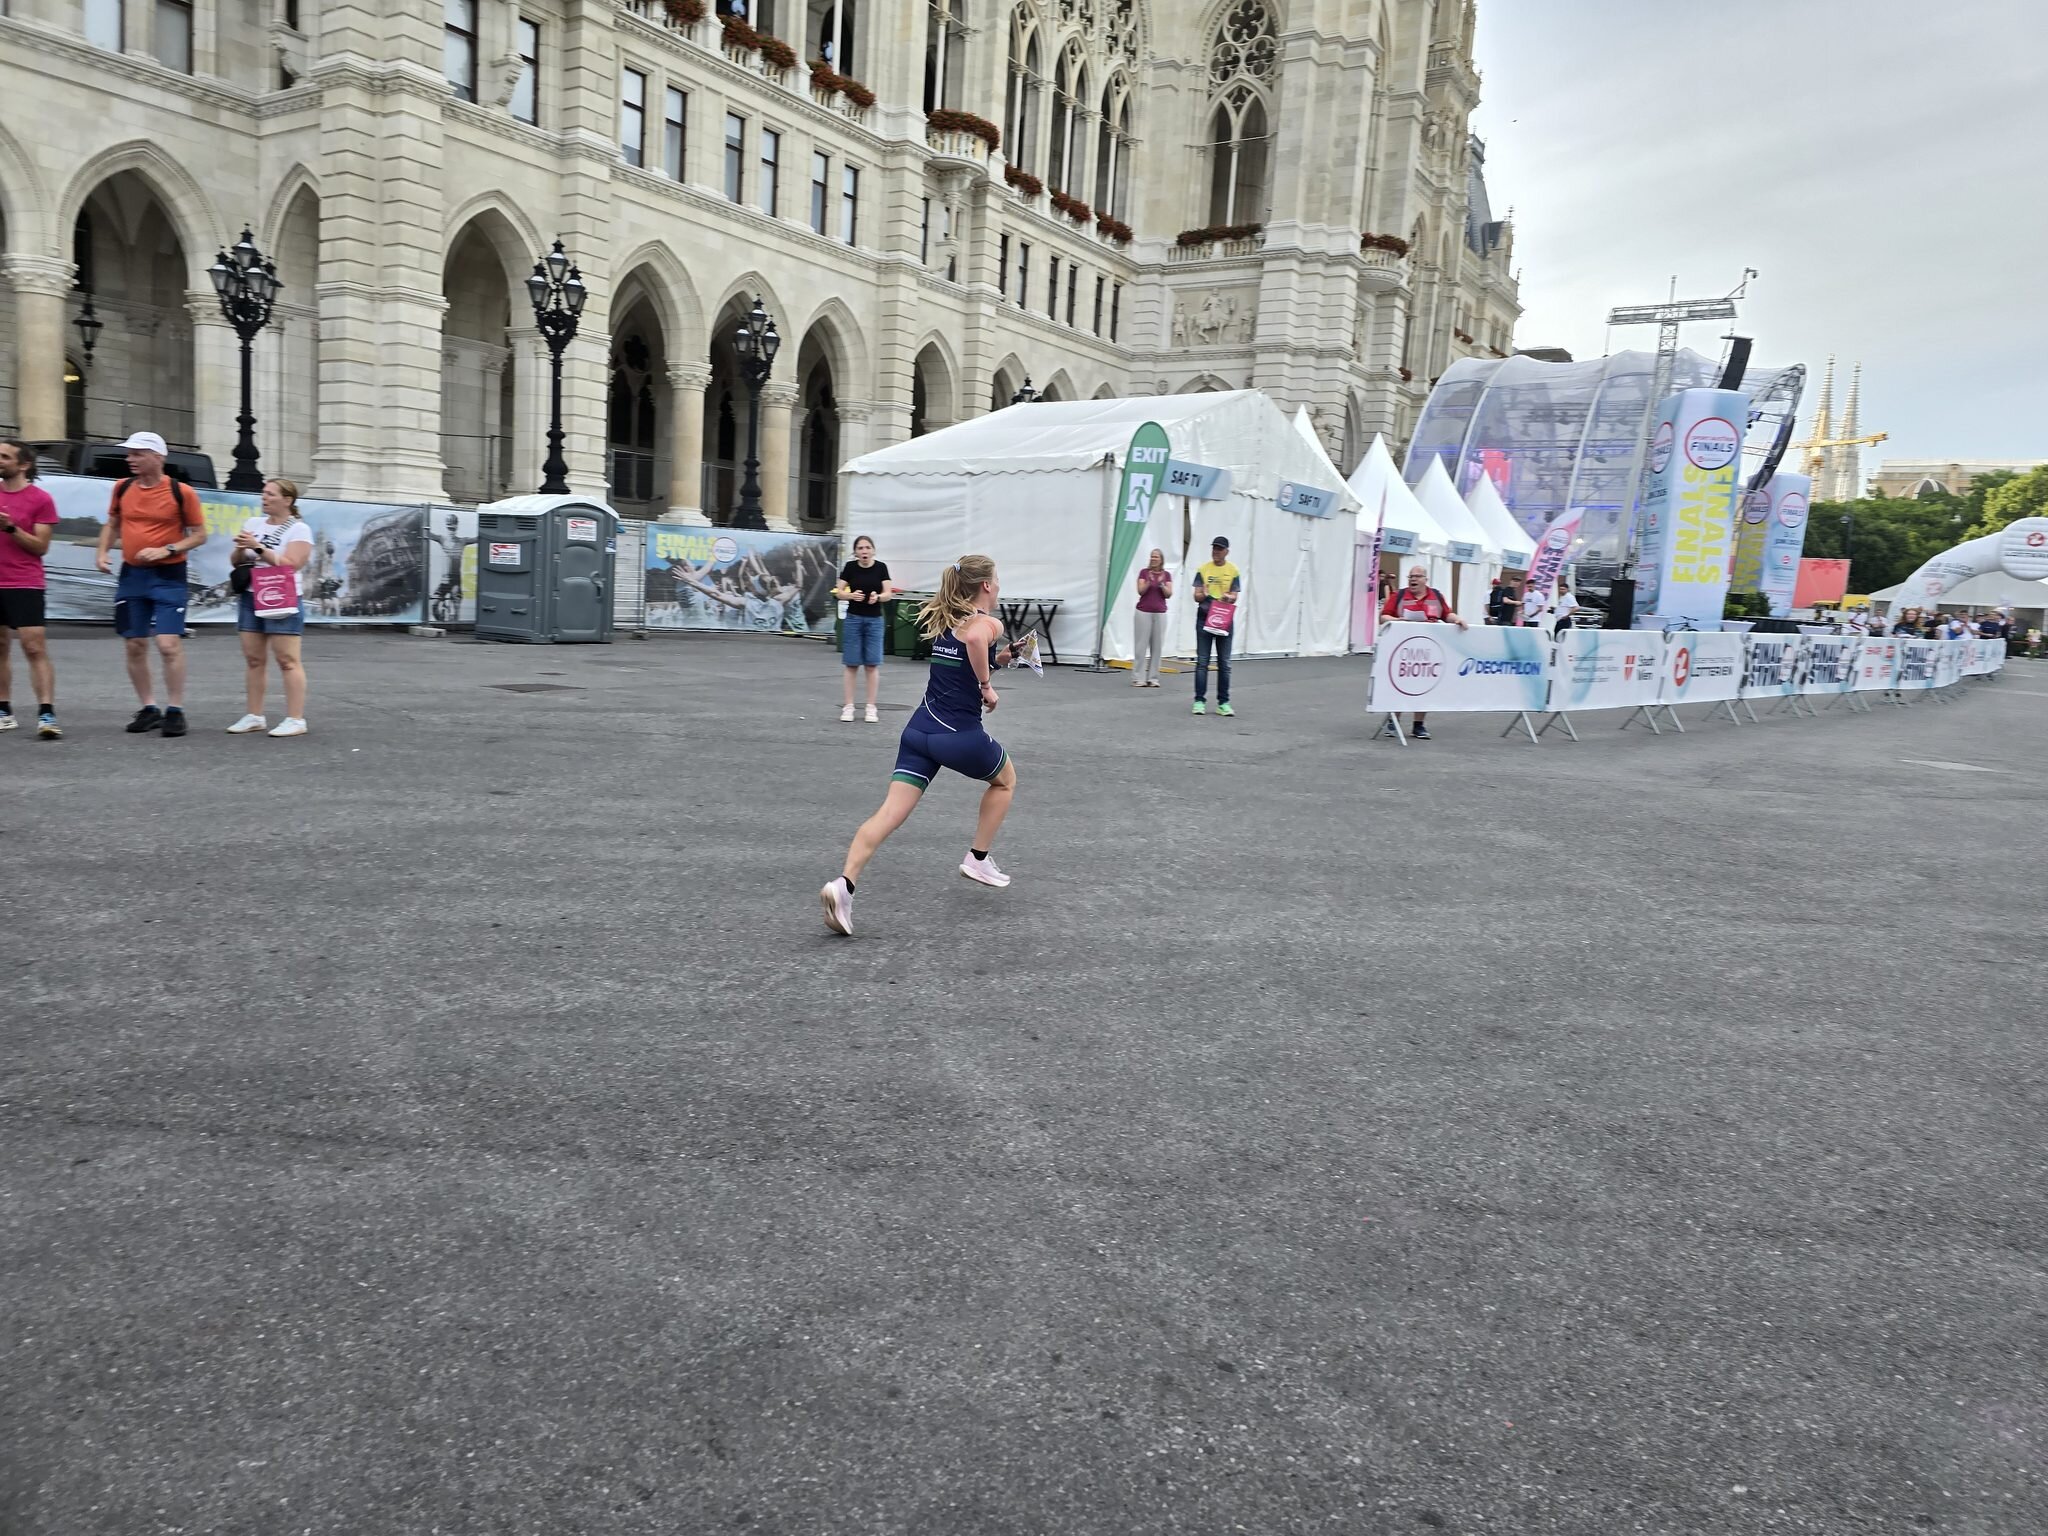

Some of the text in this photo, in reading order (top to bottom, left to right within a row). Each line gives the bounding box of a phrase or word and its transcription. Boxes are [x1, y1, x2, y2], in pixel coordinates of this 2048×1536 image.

[1132, 446, 1169, 464] EXIT
[1171, 470, 1203, 488] SAF TV
[1475, 660, 1542, 675] DECATHLON
